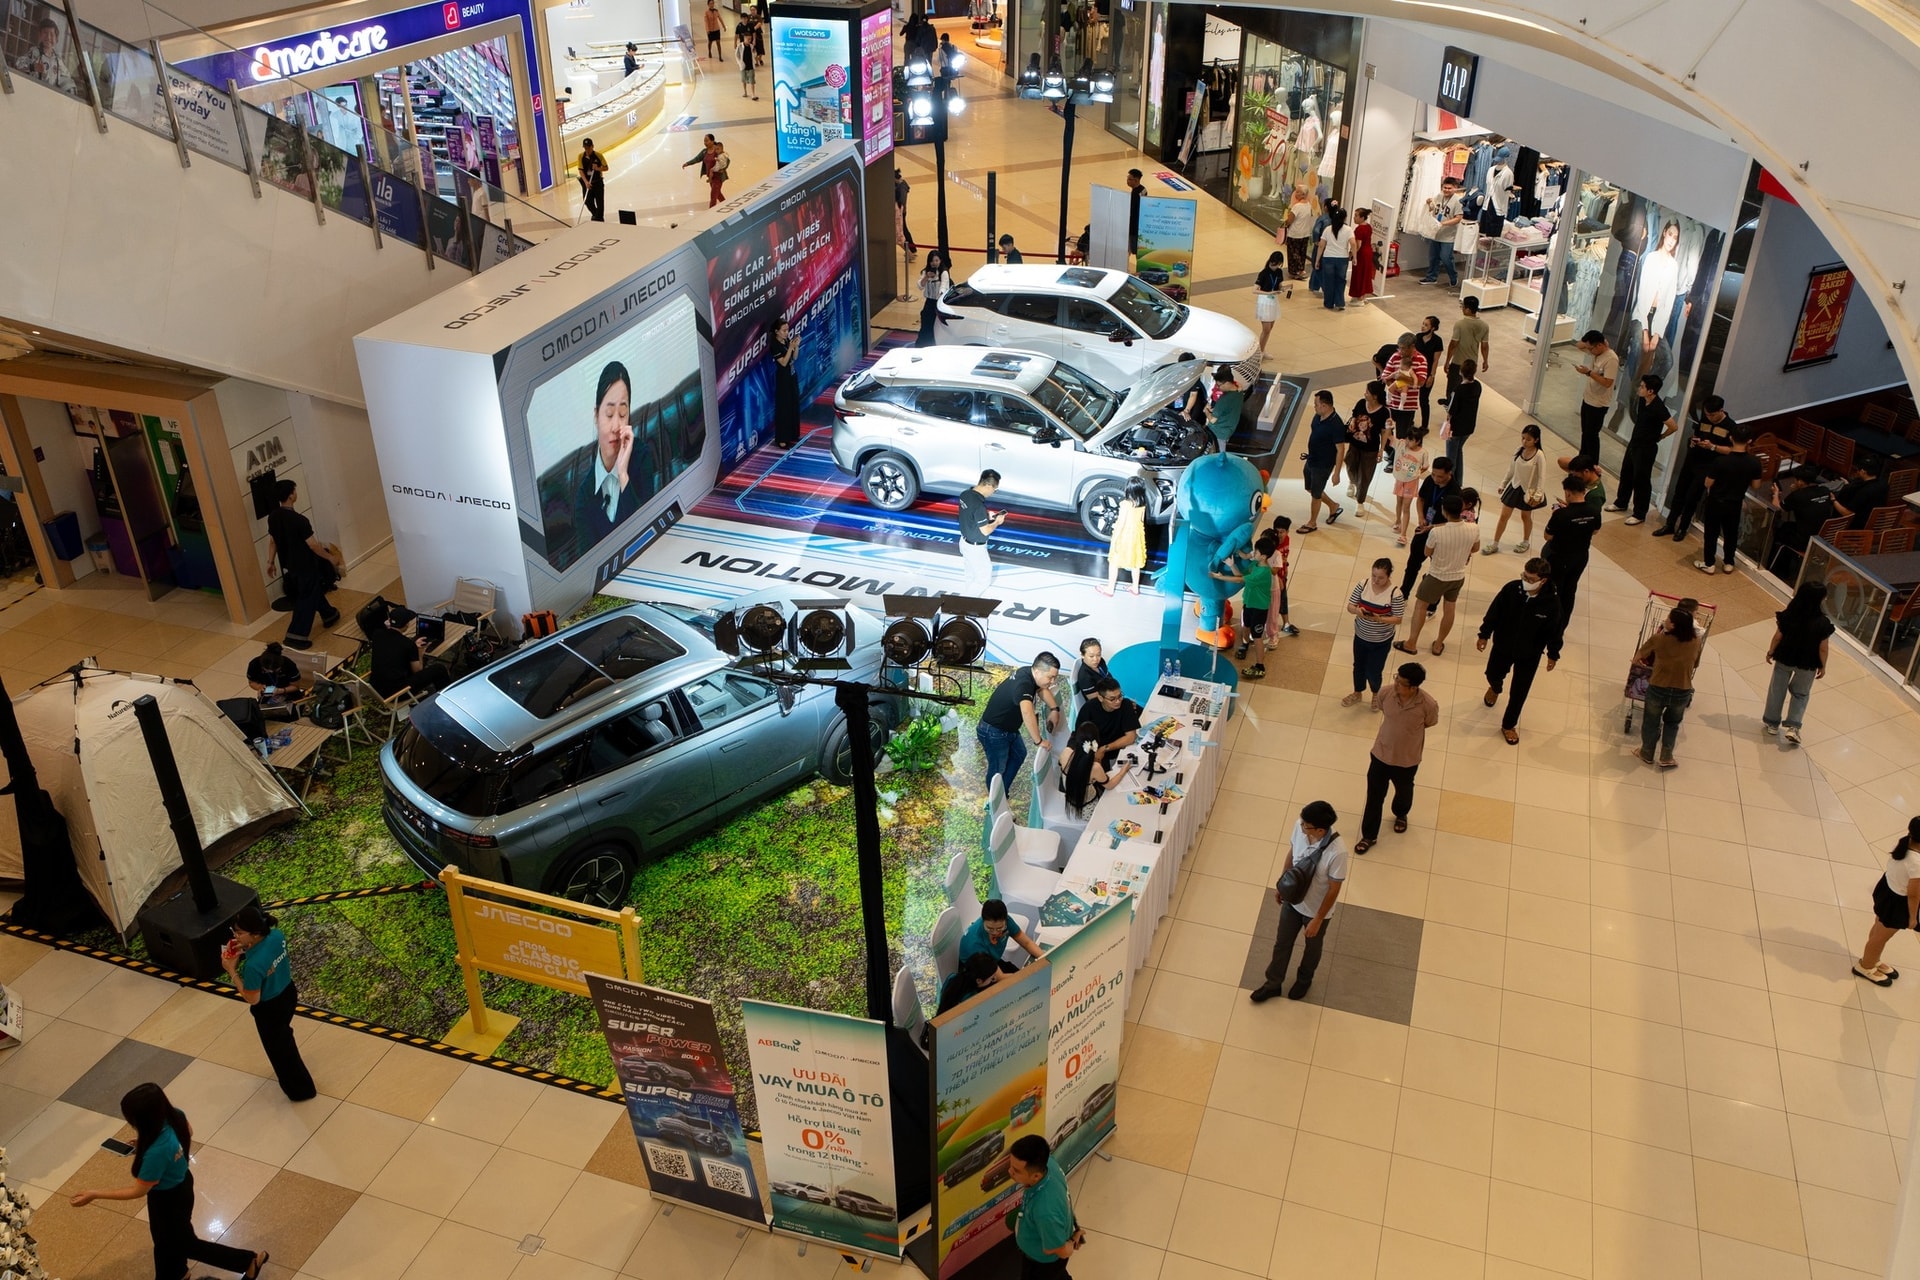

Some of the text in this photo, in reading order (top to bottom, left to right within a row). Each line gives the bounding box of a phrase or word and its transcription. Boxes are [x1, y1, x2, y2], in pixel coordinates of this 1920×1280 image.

[462, 3, 485, 18] BEAUTY
[794, 30, 826, 38] watsons
[268, 25, 388, 76] medicare
[1442, 62, 1468, 102] GAP
[205, 91, 226, 110] You
[787, 136, 816, 147] Lô F02
[376, 177, 393, 201] ila
[780, 189, 807, 211] OMODA
[1435, 203, 1450, 217] GP
[723, 269, 742, 291] ONE
[745, 256, 764, 277] CAR
[775, 235, 794, 258] TWO
[797, 220, 820, 242] VIBES
[725, 286, 750, 311] SONG
[752, 266, 777, 291] HÀNH
[779, 248, 807, 274] PHONG
[809, 232, 831, 255] CÁCH
[1821, 271, 1848, 282] FRESH
[811, 270, 851, 320] SMOOTH
[1819, 279, 1846, 291] BAKED
[541, 269, 676, 362] OMODA JAECOO
[728, 333, 767, 384] SUPER
[247, 436, 284, 471] ATM
[392, 484, 511, 510] OMODA JAECOO
[999, 544, 1051, 558] KHÁM
[680, 550, 1090, 627] AR MOTION
[474, 905, 573, 938] JAECOO
[508, 944, 580, 970] CLASSIC
[518, 940, 547, 953] FROM
[503, 953, 587, 984] BEYOND CLAS
[605, 982, 694, 1009] OMODA JAECOO
[1067, 995, 1095, 1022] MUA
[1097, 982, 1106, 999] Ô
[1108, 970, 1123, 990] TÔ
[1085, 975, 1102, 996] ĐÃI
[607, 1019, 675, 1038] SUPER
[622, 1045, 700, 1061] PASSION BOLD
[646, 1033, 711, 1053] POWER
[757, 1038, 800, 1053] ABBank
[814, 1049, 846, 1060] OMODA
[792, 1067, 847, 1087] ƯU ĐÃI
[624, 1082, 692, 1102] SUPER
[758, 1073, 884, 1108] VAY MUA Ô TÔ
[788, 1101, 811, 1111] Omoda
[818, 1107, 842, 1117] Jaecoo
[842, 1112, 855, 1121] Việt
[856, 1115, 872, 1123] Nam
[794, 1096, 807, 1104] cho
[807, 1098, 827, 1108] khách
[828, 1102, 844, 1112] hàng
[844, 1107, 859, 1115] mua
[787, 1113, 862, 1137] Hỗ trợ lãi suất
[787, 1144, 816, 1159] trong
[818, 1150, 829, 1160] 12
[831, 1152, 862, 1168] tháng
